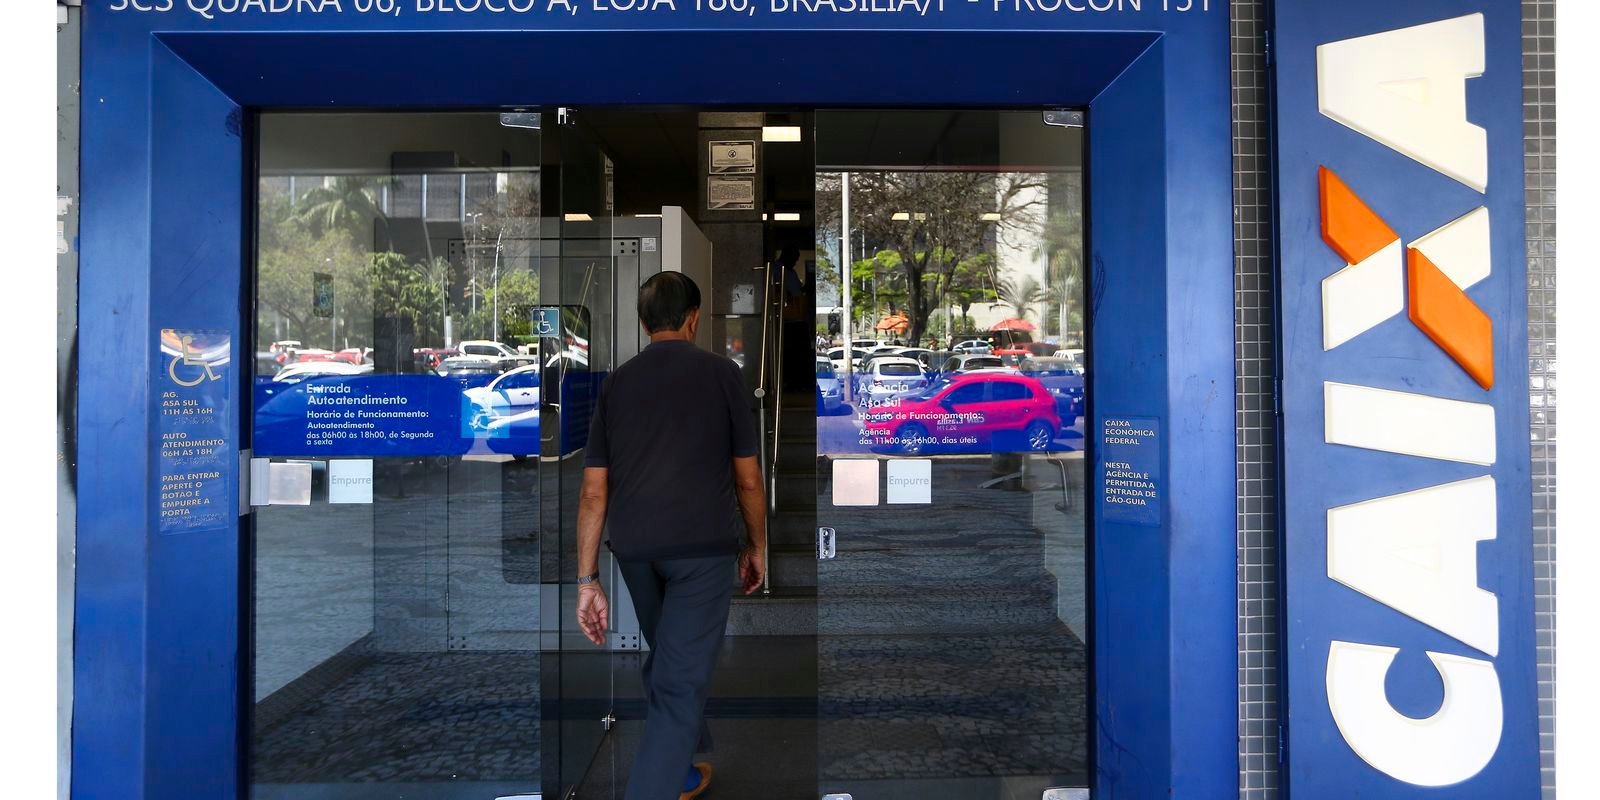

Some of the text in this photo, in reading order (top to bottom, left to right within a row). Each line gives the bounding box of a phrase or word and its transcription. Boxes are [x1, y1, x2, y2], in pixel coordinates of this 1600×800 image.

[306, 383, 351, 394] Entrada
[307, 394, 408, 406] Autoatendimento
[1317, 12, 1503, 787] CAIXA
[306, 410, 429, 418] Horário de Funcionamento:
[895, 411, 907, 420] de
[307, 421, 375, 429] Autoatendimento
[163, 432, 187, 440] AUTO
[306, 431, 321, 439] das
[321, 431, 347, 439] 06h00
[360, 430, 387, 439] 18h00,
[400, 430, 434, 440] Segunda
[163, 439, 224, 449] ATENDIMENTO
[941, 436, 957, 444] dias
[1105, 437, 1140, 445] FEDERAL
[1105, 462, 1131, 470] NESTA
[162, 472, 220, 482] PARA ENTRAR
[331, 475, 371, 486] Empurre
[889, 475, 929, 488] Empurre
[162, 482, 193, 491] APERTE
[1106, 479, 1147, 488] PERMITIDA
[1105, 488, 1143, 497] ENTRADA
[162, 499, 202, 508] EMPURRE
[162, 508, 190, 517] PORTA
